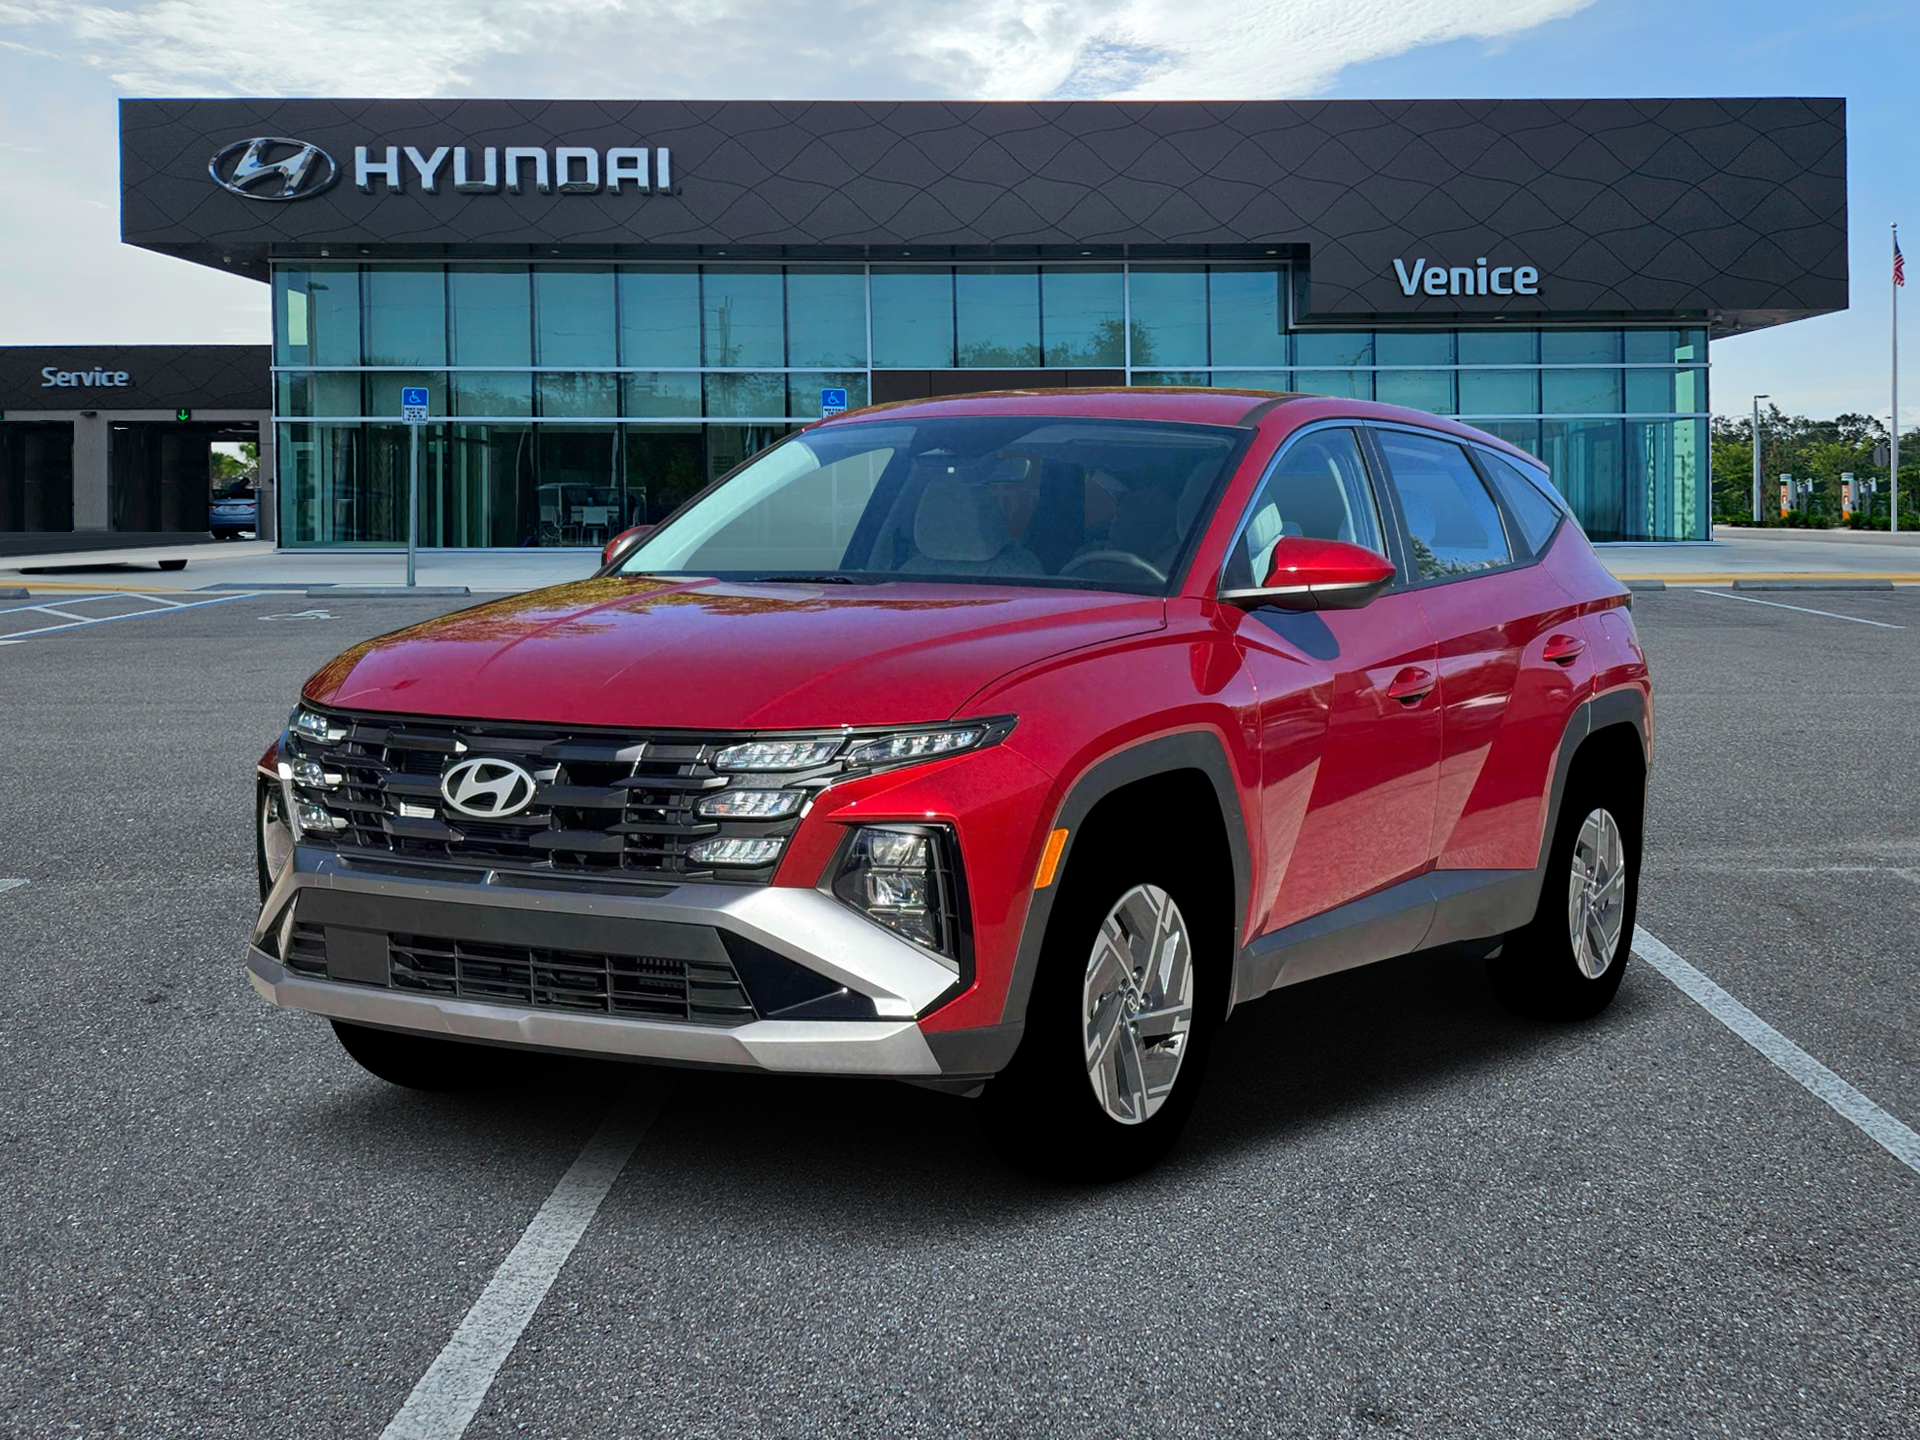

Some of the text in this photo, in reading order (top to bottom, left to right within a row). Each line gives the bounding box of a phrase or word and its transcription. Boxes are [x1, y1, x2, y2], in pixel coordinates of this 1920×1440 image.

[355, 146, 672, 193] HYUNDAI
[1393, 257, 1538, 295] Venice
[41, 367, 129, 387] Service
